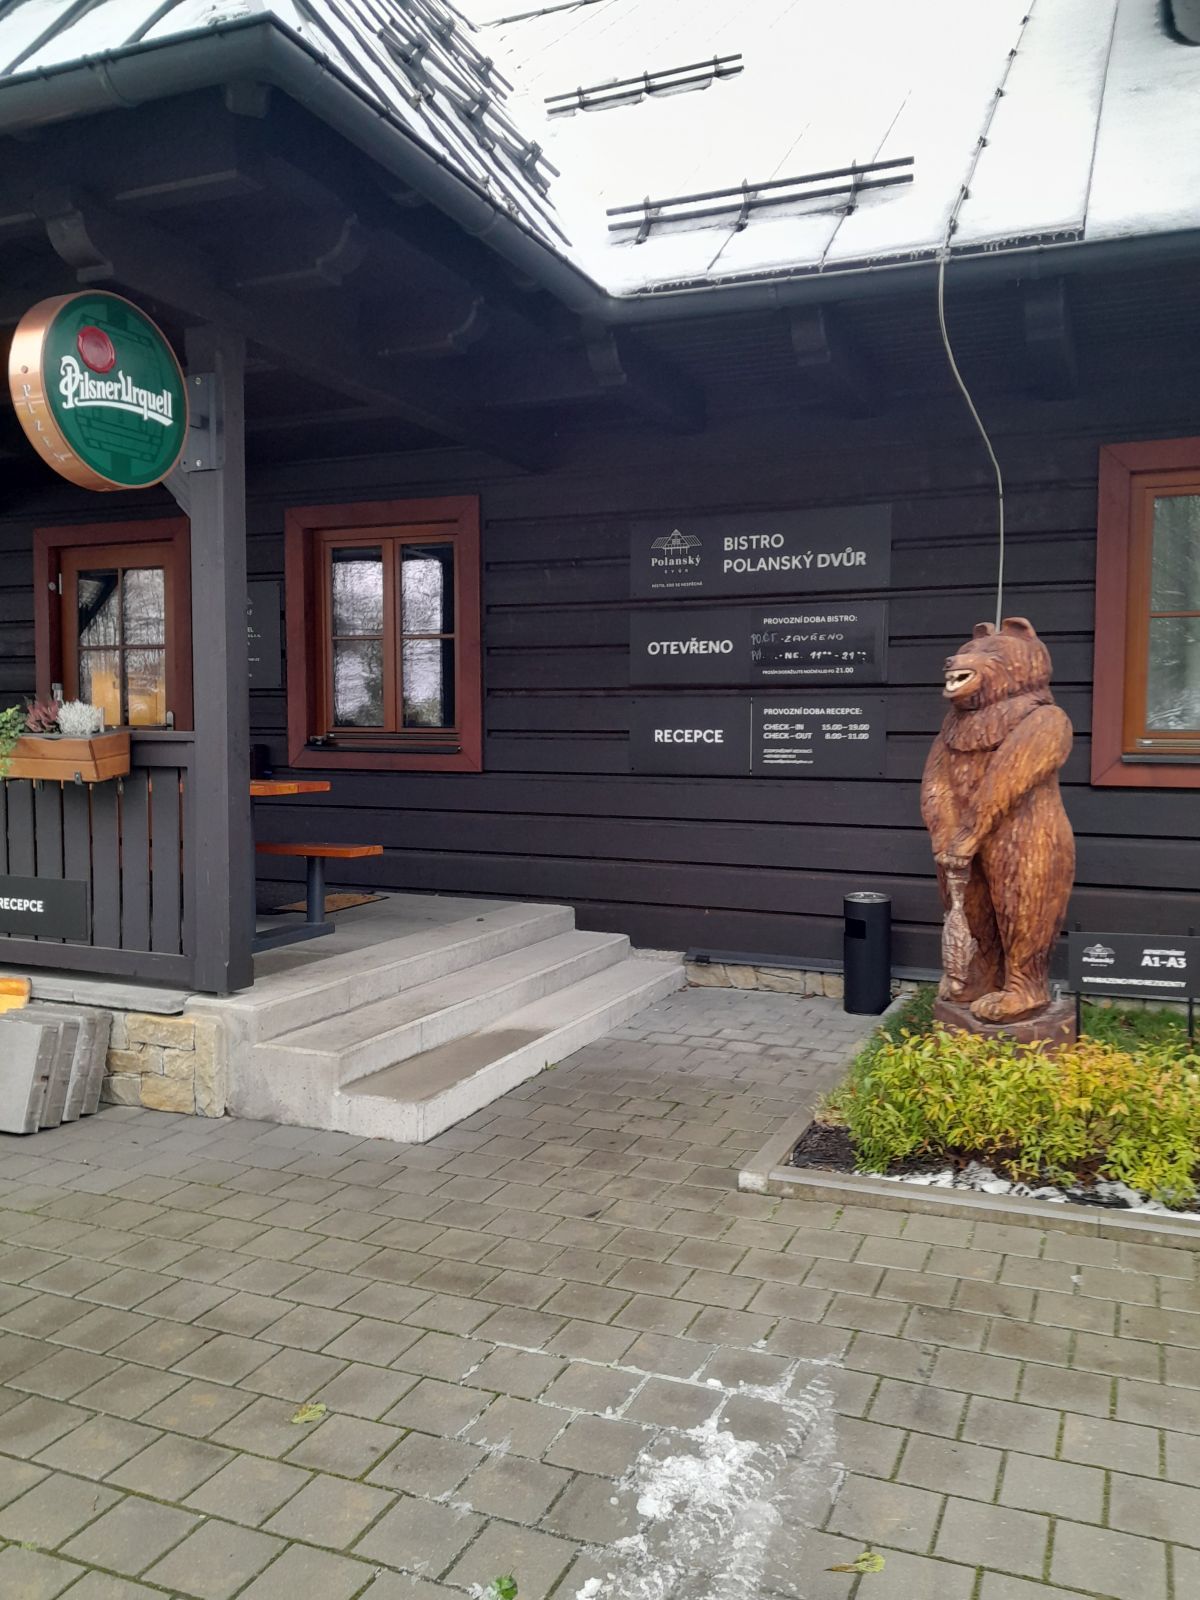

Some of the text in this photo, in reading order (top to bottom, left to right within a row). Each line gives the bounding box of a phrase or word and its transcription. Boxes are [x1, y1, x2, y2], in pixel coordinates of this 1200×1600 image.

[59, 355, 173, 421] Pilsner Urquell
[723, 533, 784, 551] BISTRO
[651, 554, 701, 567] Polanský
[723, 547, 867, 573] POLANSKÝ DVŮR
[763, 614, 858, 624] PROVOZNÍ DOBA BISTRO:
[647, 637, 734, 655] OTEVŘENO
[763, 706, 802, 715] PROVOZNÍ
[826, 707, 863, 715] RECEPCE:
[654, 729, 724, 743] RECEPCE
[0, 897, 44, 912] RECEPCE
